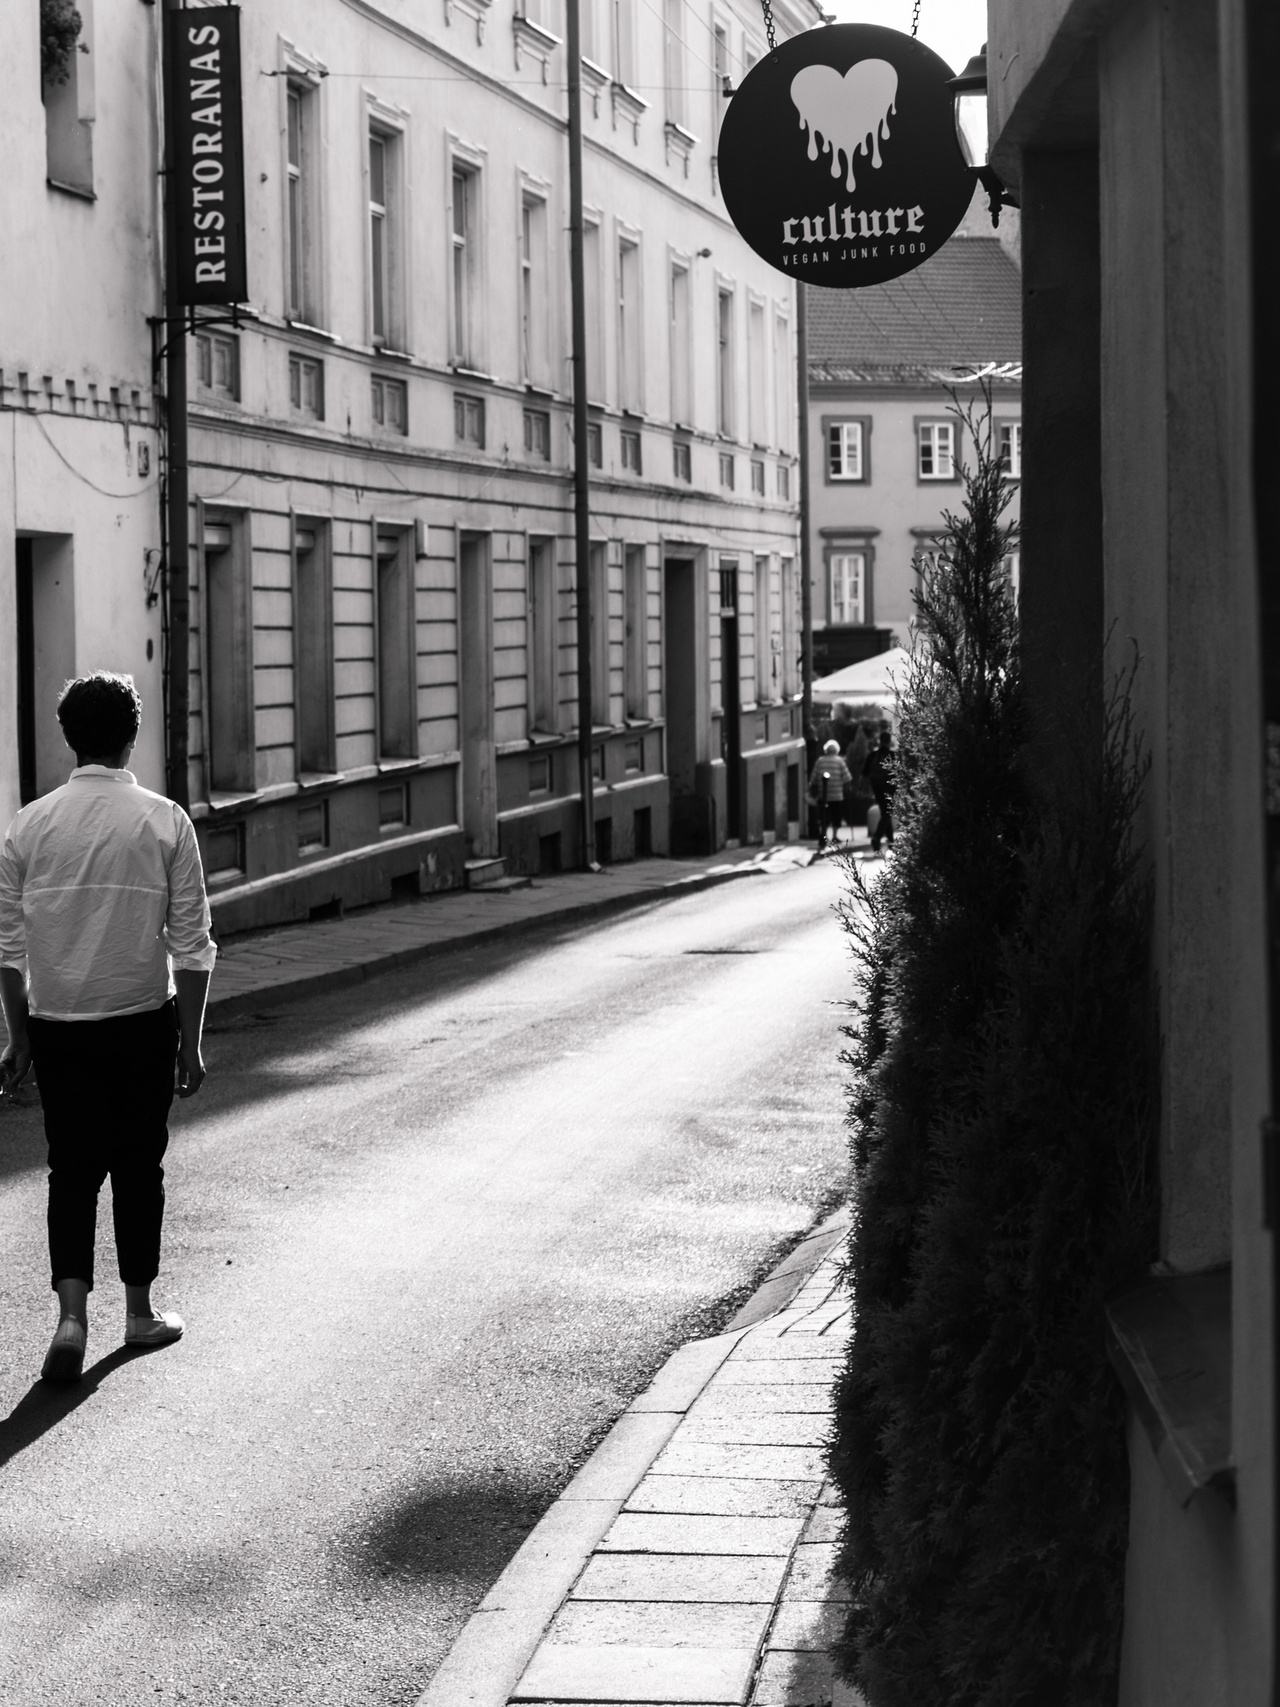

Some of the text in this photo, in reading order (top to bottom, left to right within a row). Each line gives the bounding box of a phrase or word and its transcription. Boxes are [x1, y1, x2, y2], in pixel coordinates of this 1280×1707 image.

[188, 25, 226, 283] RESTORANAS
[782, 202, 925, 245] culture
[783, 242, 926, 266] VEGAN JUNK FOOD
